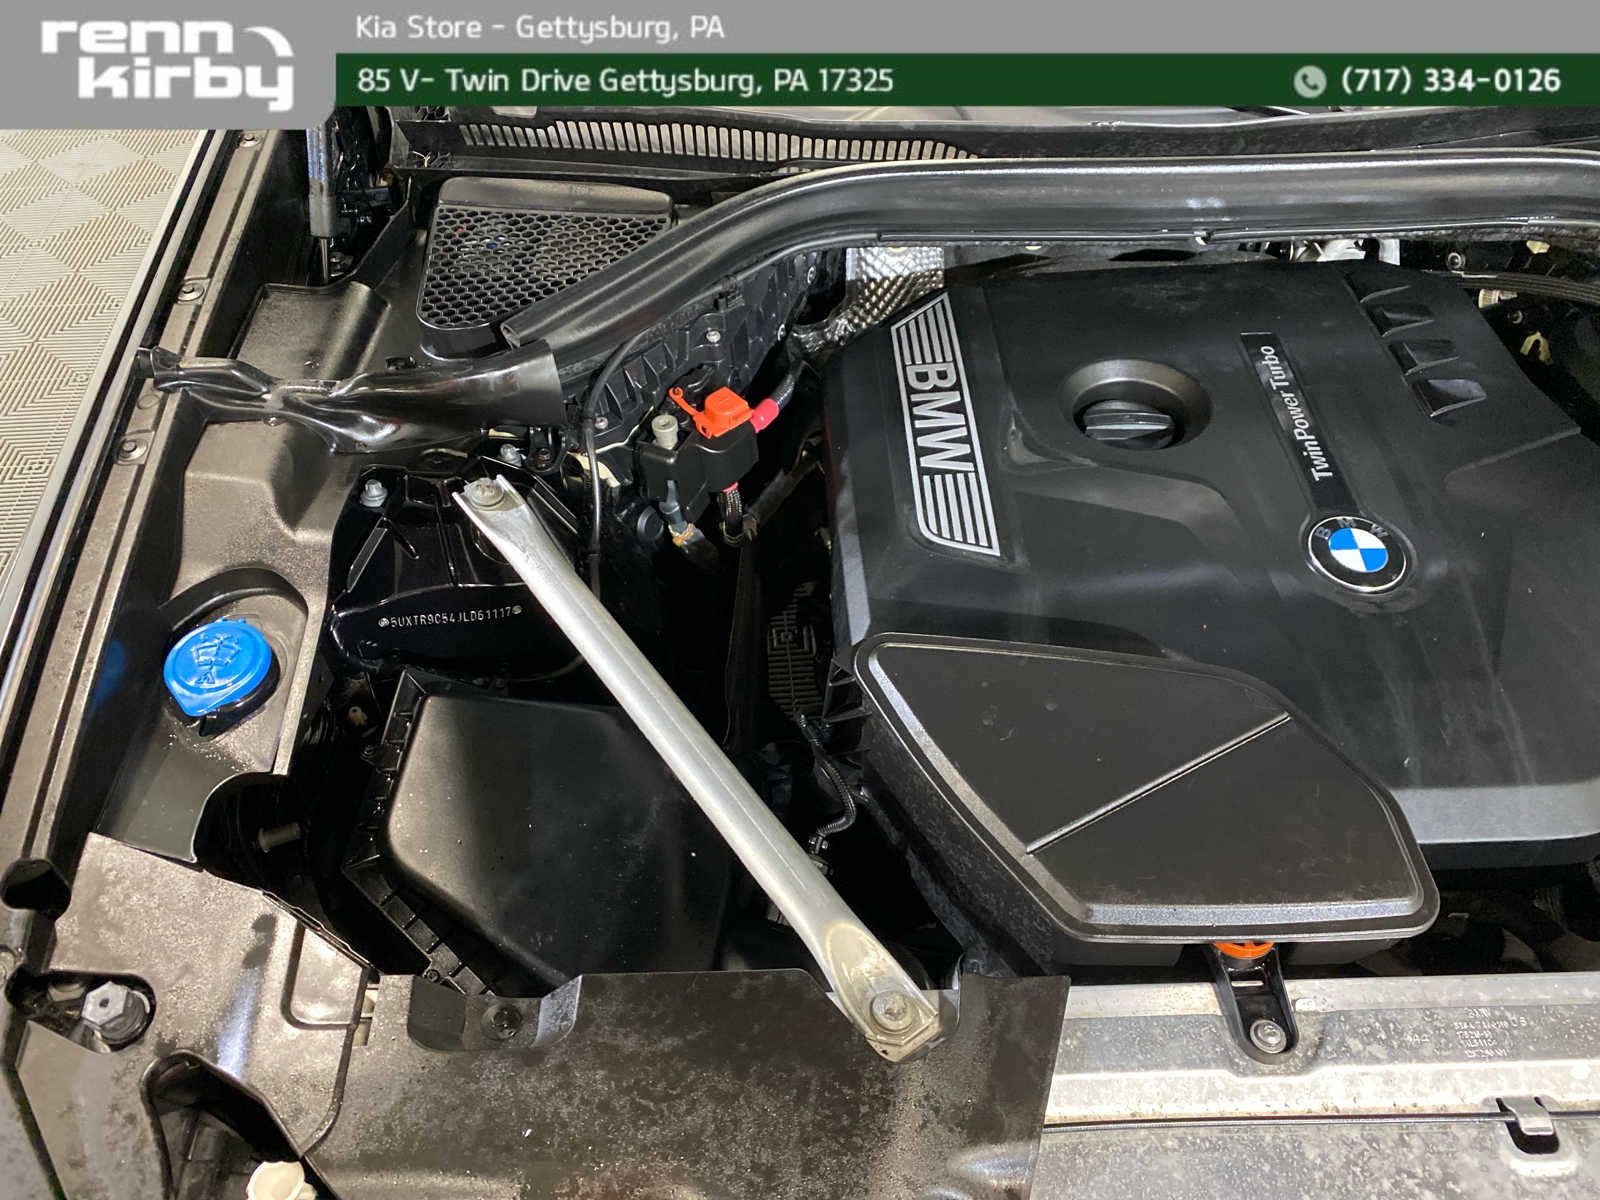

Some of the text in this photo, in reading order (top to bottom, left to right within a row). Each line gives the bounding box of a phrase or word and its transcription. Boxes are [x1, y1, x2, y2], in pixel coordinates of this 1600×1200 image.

[906, 361, 975, 472] BMW
[1260, 345, 1333, 482] TwinPower Turbo
[1314, 516, 1390, 541] BMW
